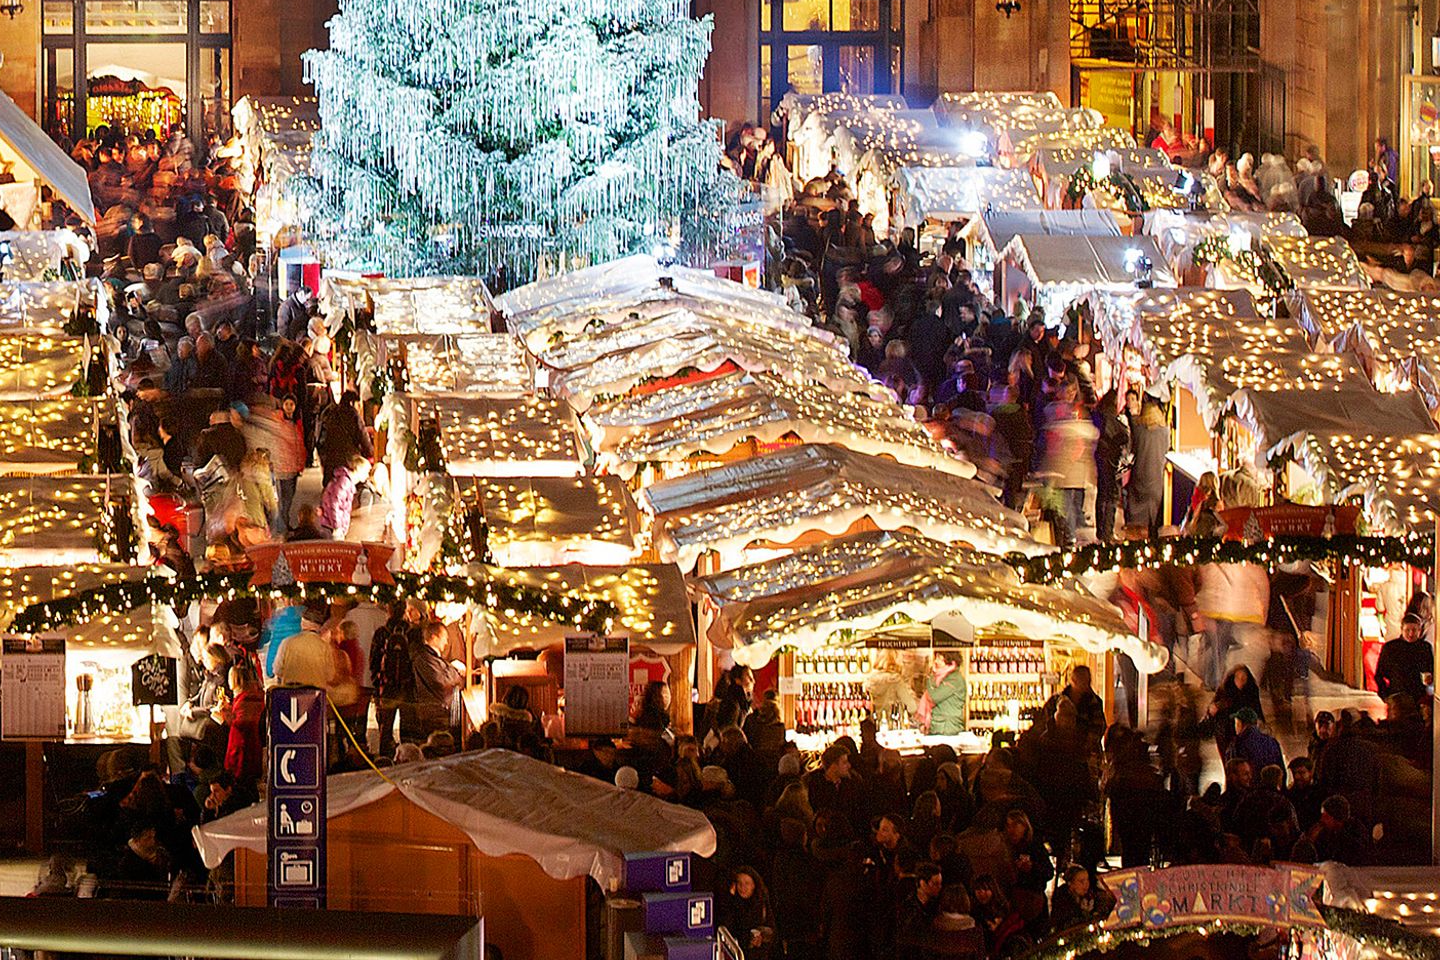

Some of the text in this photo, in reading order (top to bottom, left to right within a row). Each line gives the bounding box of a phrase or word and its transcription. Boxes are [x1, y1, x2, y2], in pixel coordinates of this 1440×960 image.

[480, 224, 546, 238] SWAROVSKI
[1270, 524, 1311, 533] MARKT
[300, 564, 343, 572] MARKT
[1172, 891, 1258, 913] MARKT
